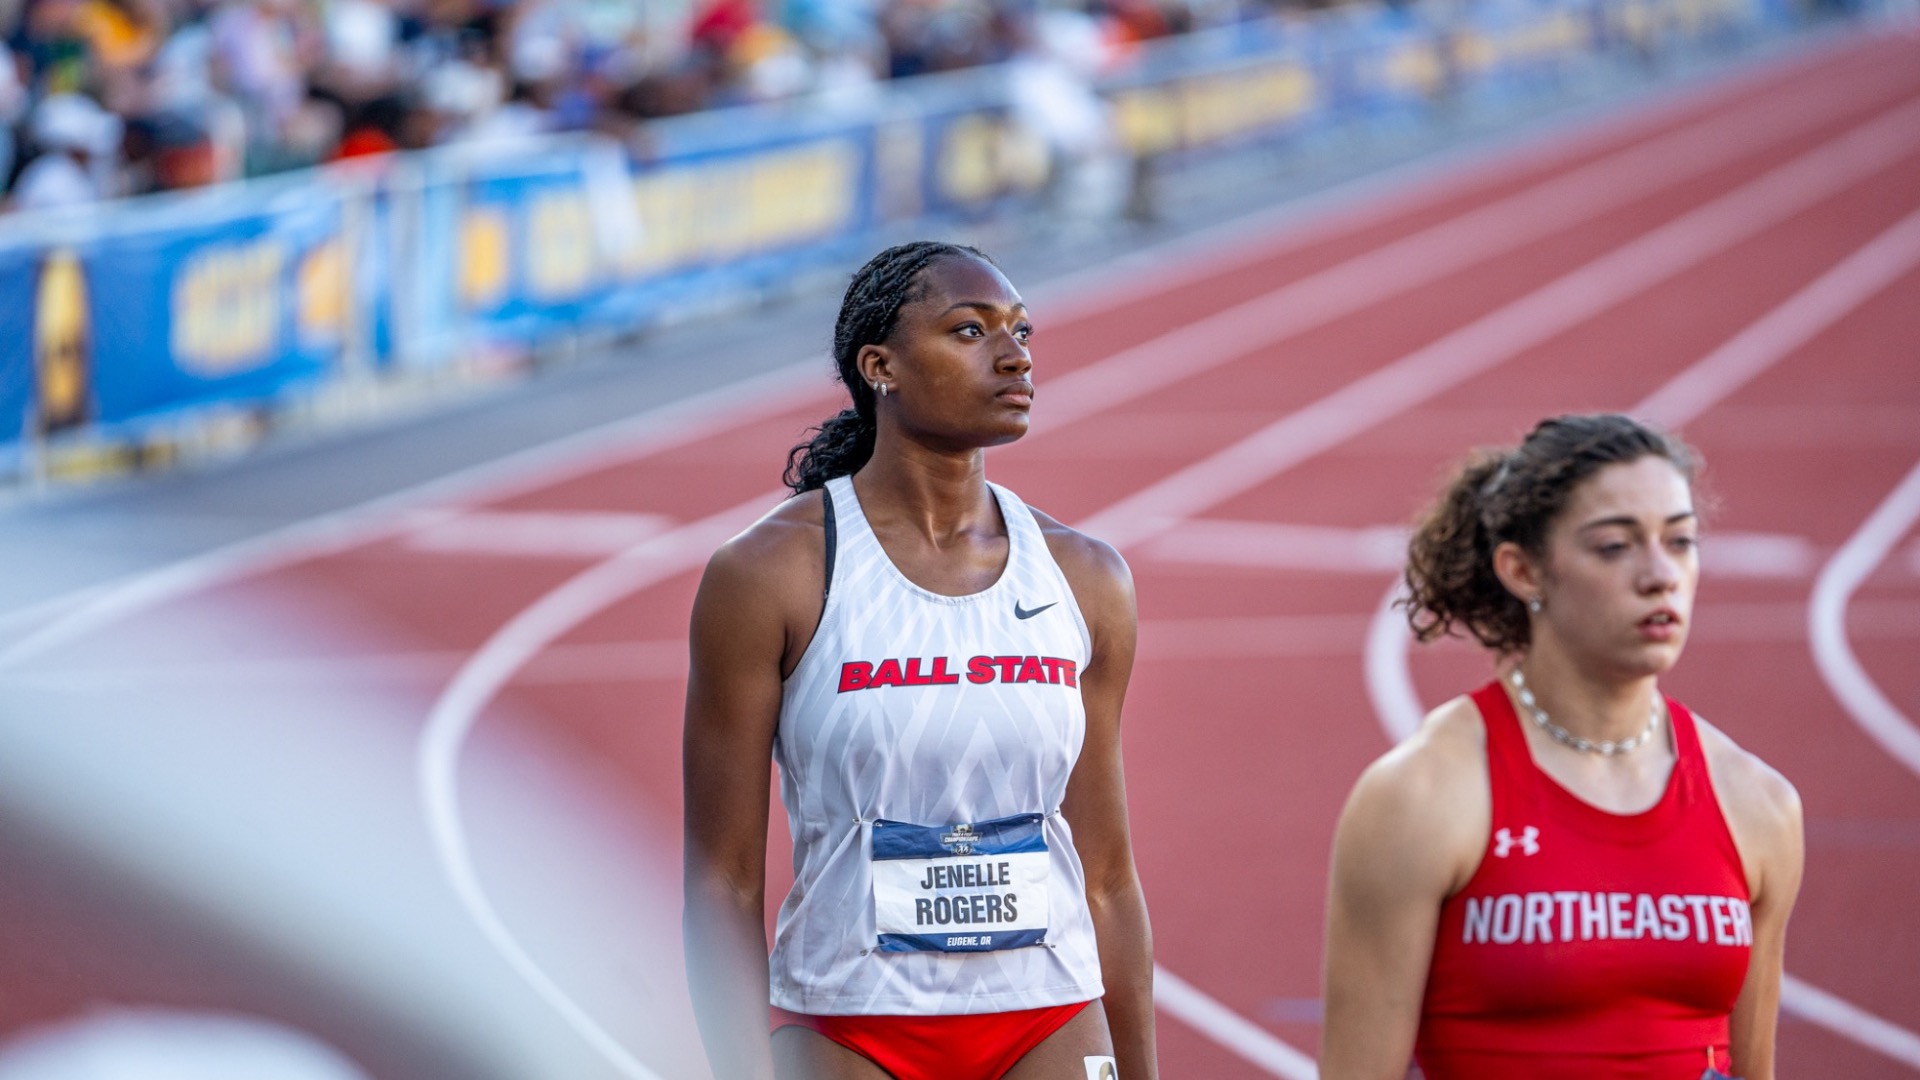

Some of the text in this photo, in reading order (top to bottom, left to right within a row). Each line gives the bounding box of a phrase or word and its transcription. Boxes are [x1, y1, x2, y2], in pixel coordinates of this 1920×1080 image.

[837, 655, 1077, 694] BALL STATE
[920, 862, 1011, 890] JENELLE
[915, 893, 1018, 925] ROGERS
[1462, 890, 1753, 947] NORTHEASTER
[947, 935, 992, 947] EUGENE, OR
